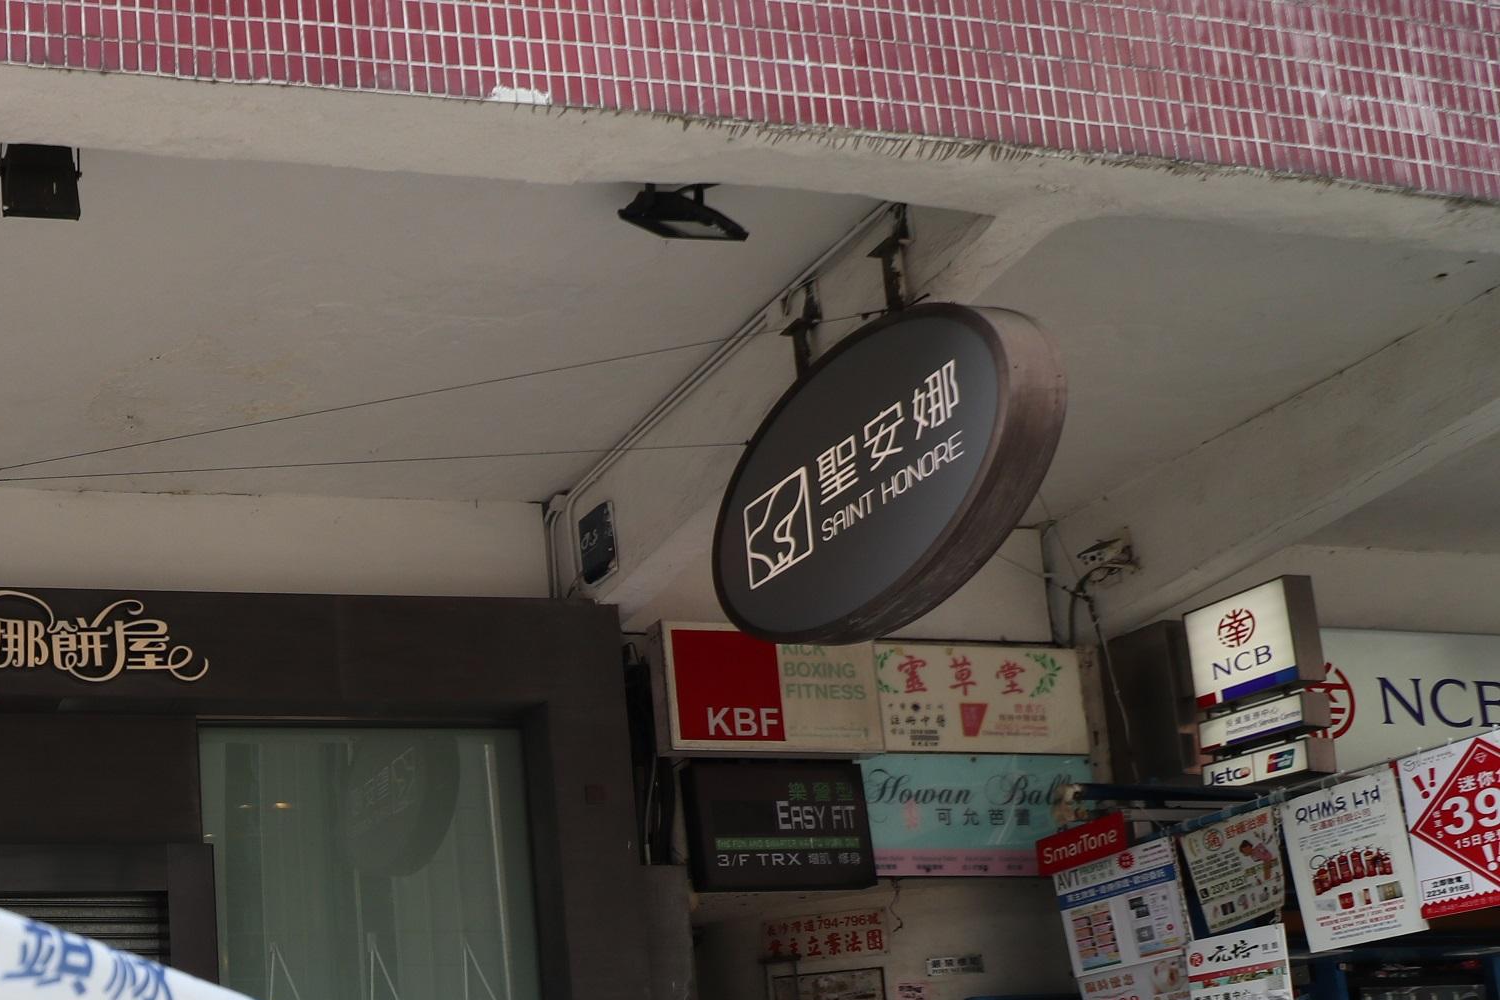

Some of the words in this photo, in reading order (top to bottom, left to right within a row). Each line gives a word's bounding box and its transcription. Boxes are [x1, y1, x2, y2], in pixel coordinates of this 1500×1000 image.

[815, 358, 961, 506] 聖安娜
[820, 486, 877, 543] SAINT
[880, 429, 965, 505] HONORE
[783, 661, 857, 680] BOXING
[1212, 644, 1273, 681] NCB
[785, 683, 868, 701] FITNESS
[705, 706, 781, 737] KBF
[866, 769, 972, 807] Howan
[1457, 770, 1500, 793] 迷你
[775, 799, 826, 830] EASY
[830, 805, 856, 830] FIT
[716, 853, 751, 867] 3/F
[756, 852, 803, 867] TRX
[1043, 828, 1118, 865] SmarTone
[1057, 869, 1080, 891] AVT
